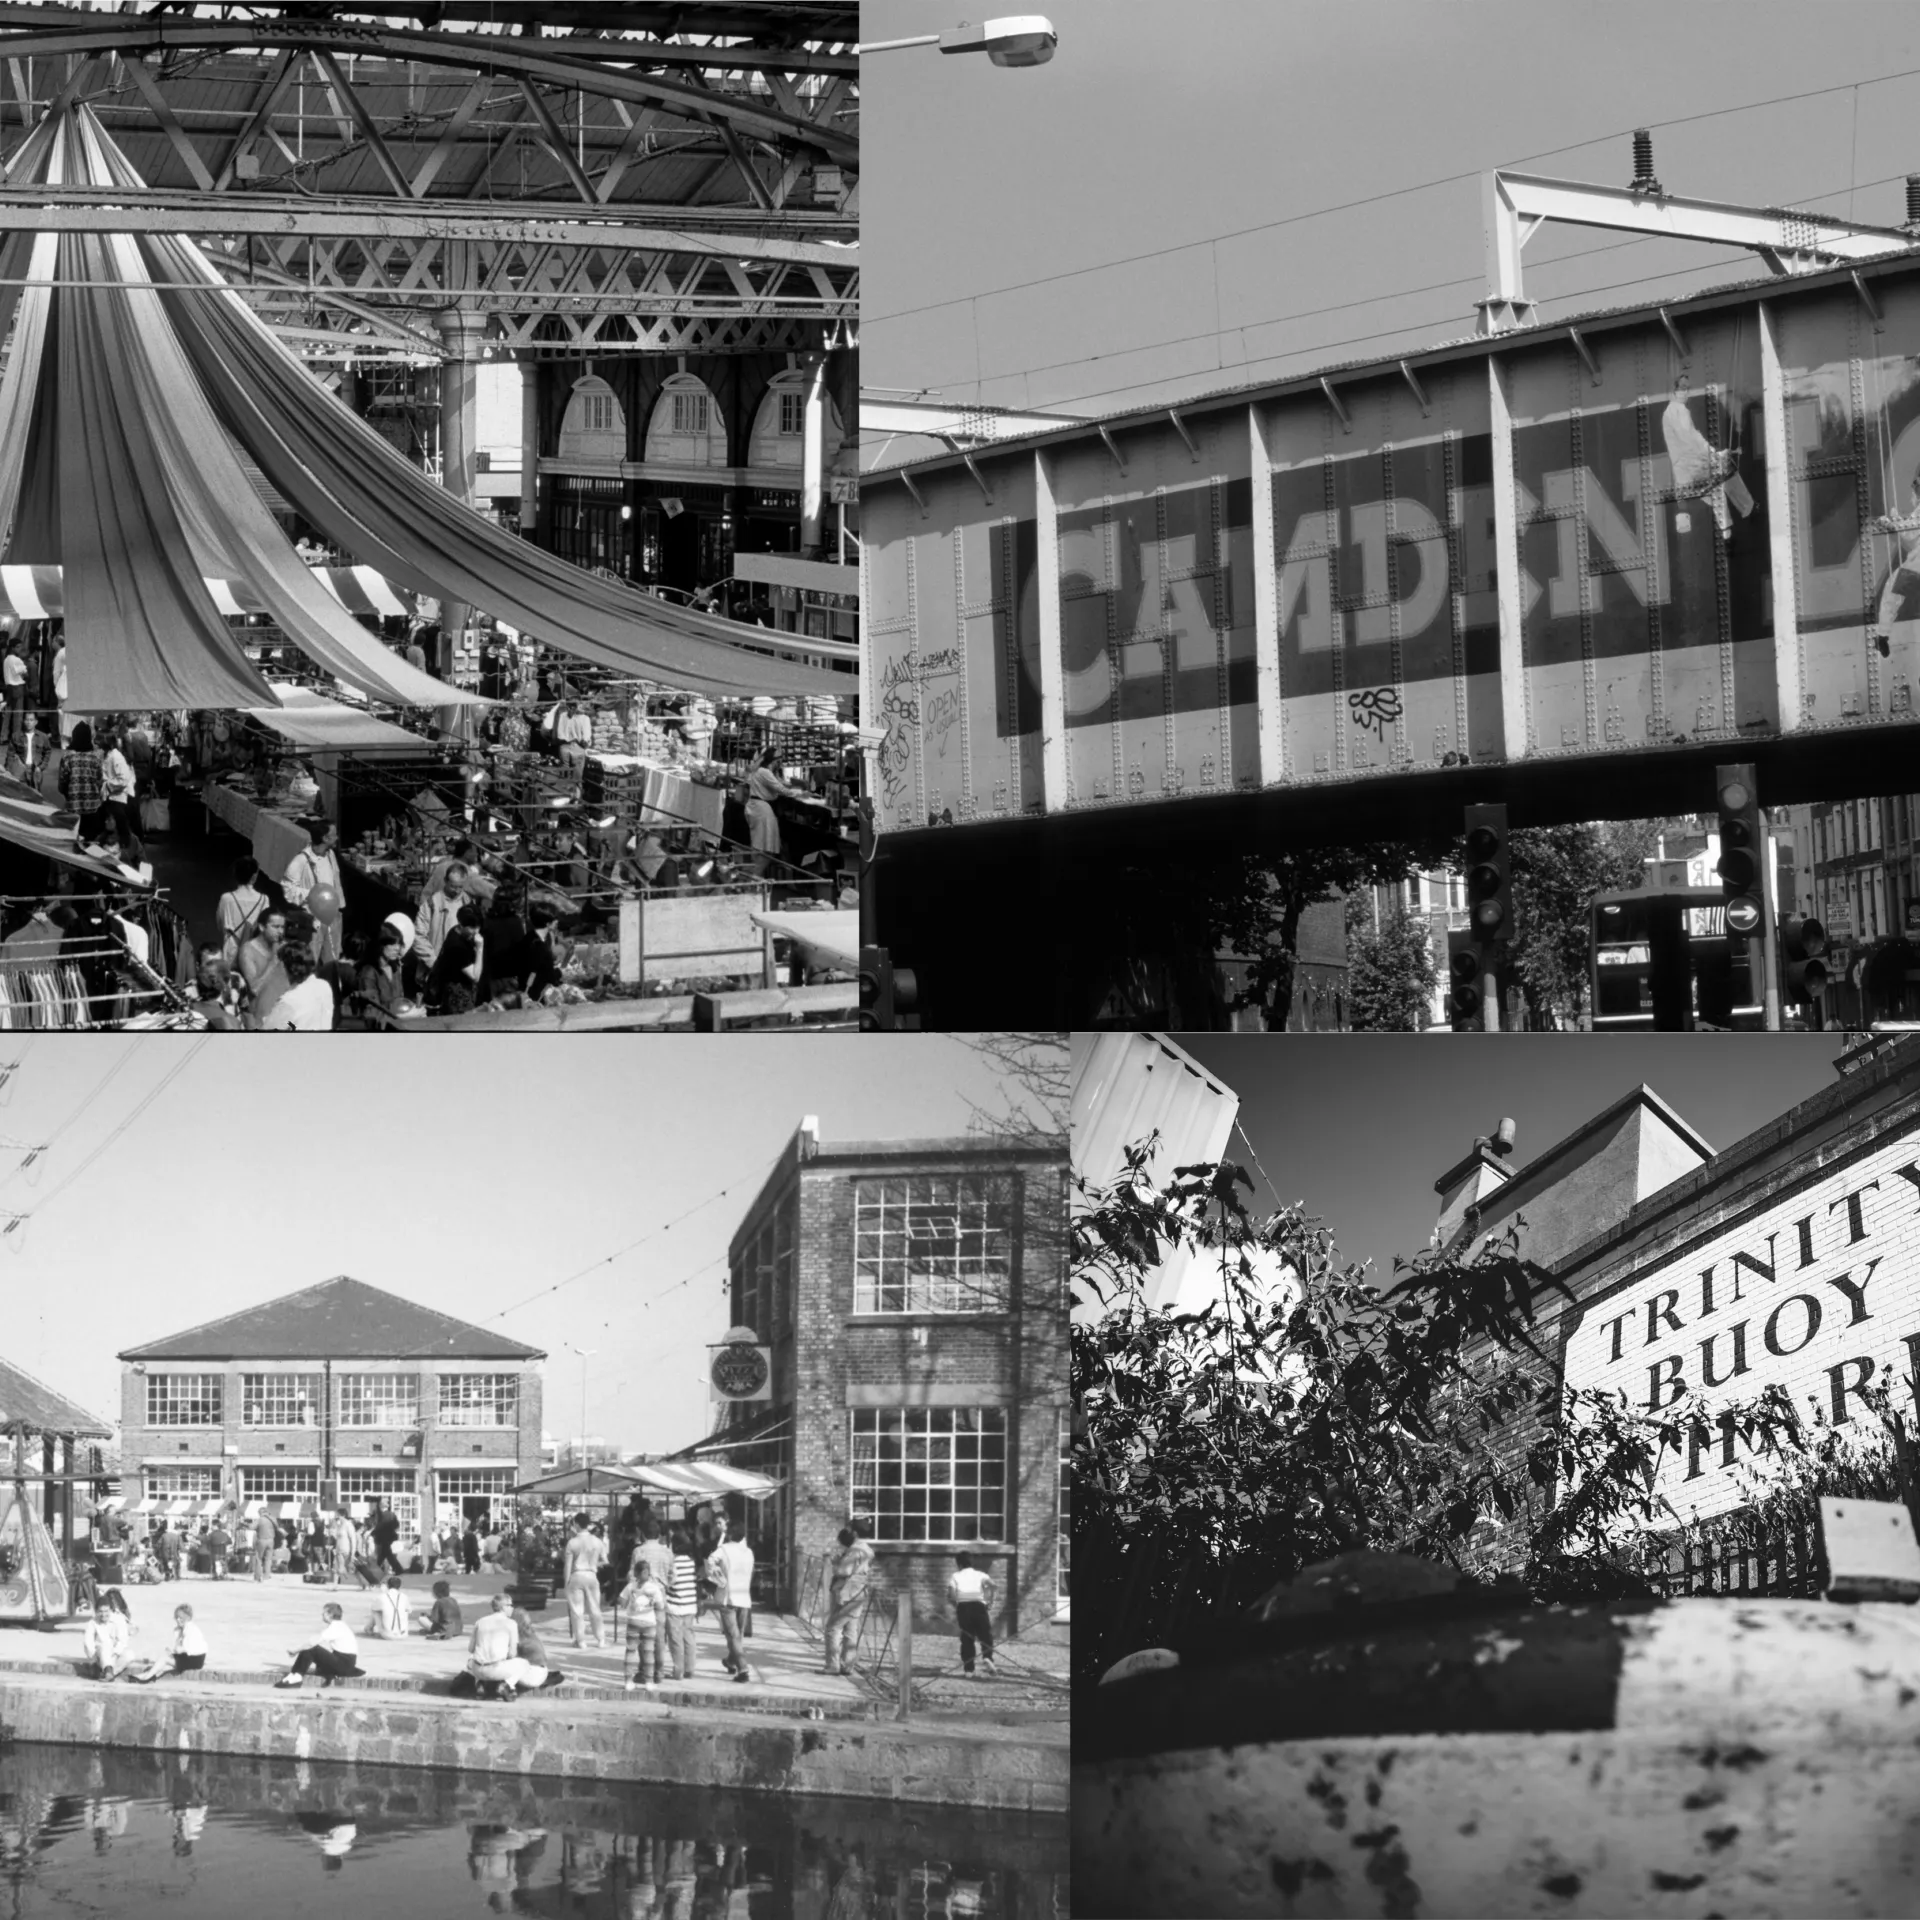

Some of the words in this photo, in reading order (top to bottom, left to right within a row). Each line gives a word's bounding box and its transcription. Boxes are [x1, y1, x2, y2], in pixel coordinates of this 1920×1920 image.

[1018, 452, 1672, 718] CAMDEN
[927, 686, 960, 724] OPEN
[1646, 1256, 1884, 1414] BUOY
